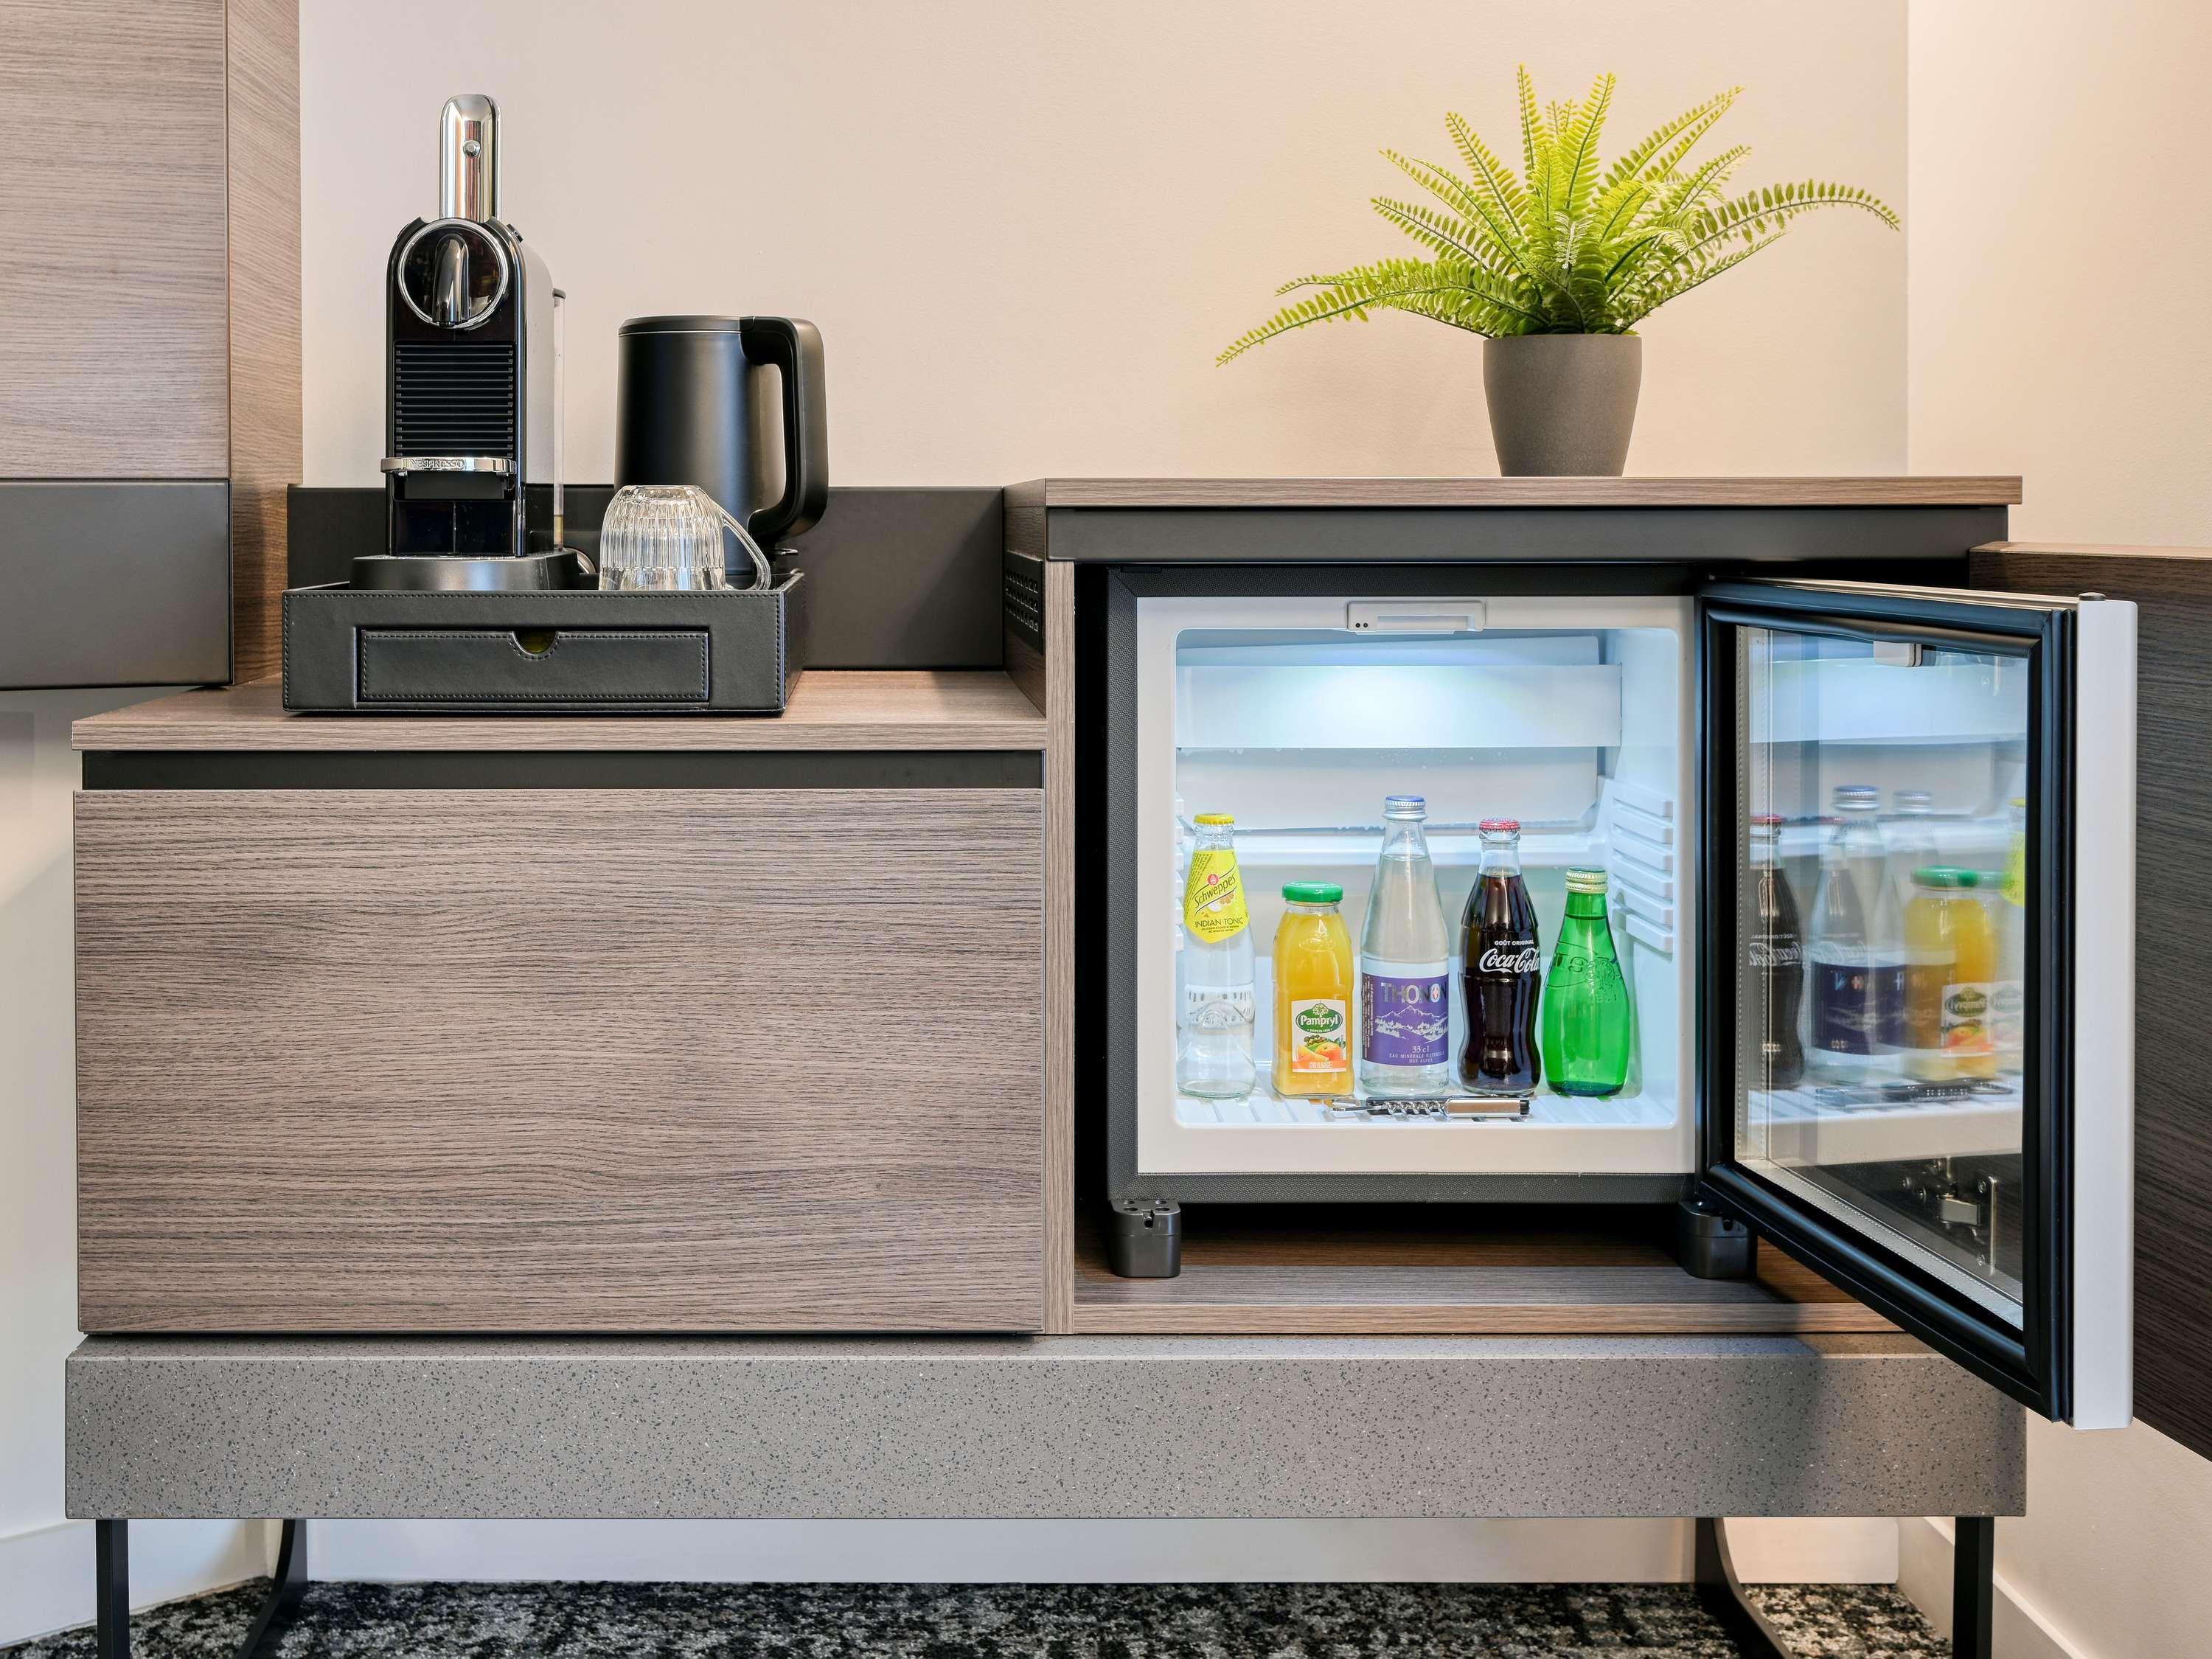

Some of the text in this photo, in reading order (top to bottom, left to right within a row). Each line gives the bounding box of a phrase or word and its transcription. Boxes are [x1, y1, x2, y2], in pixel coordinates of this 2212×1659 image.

[408, 458, 466, 470] NESPRESSO
[1194, 873, 1237, 908] Schweppes
[1195, 917, 1244, 928] INDIAN TONIC
[1380, 981, 1447, 1004] THONON
[1300, 1014, 1338, 1028] Pampryl
[1309, 1061, 1333, 1069] ORANGE
